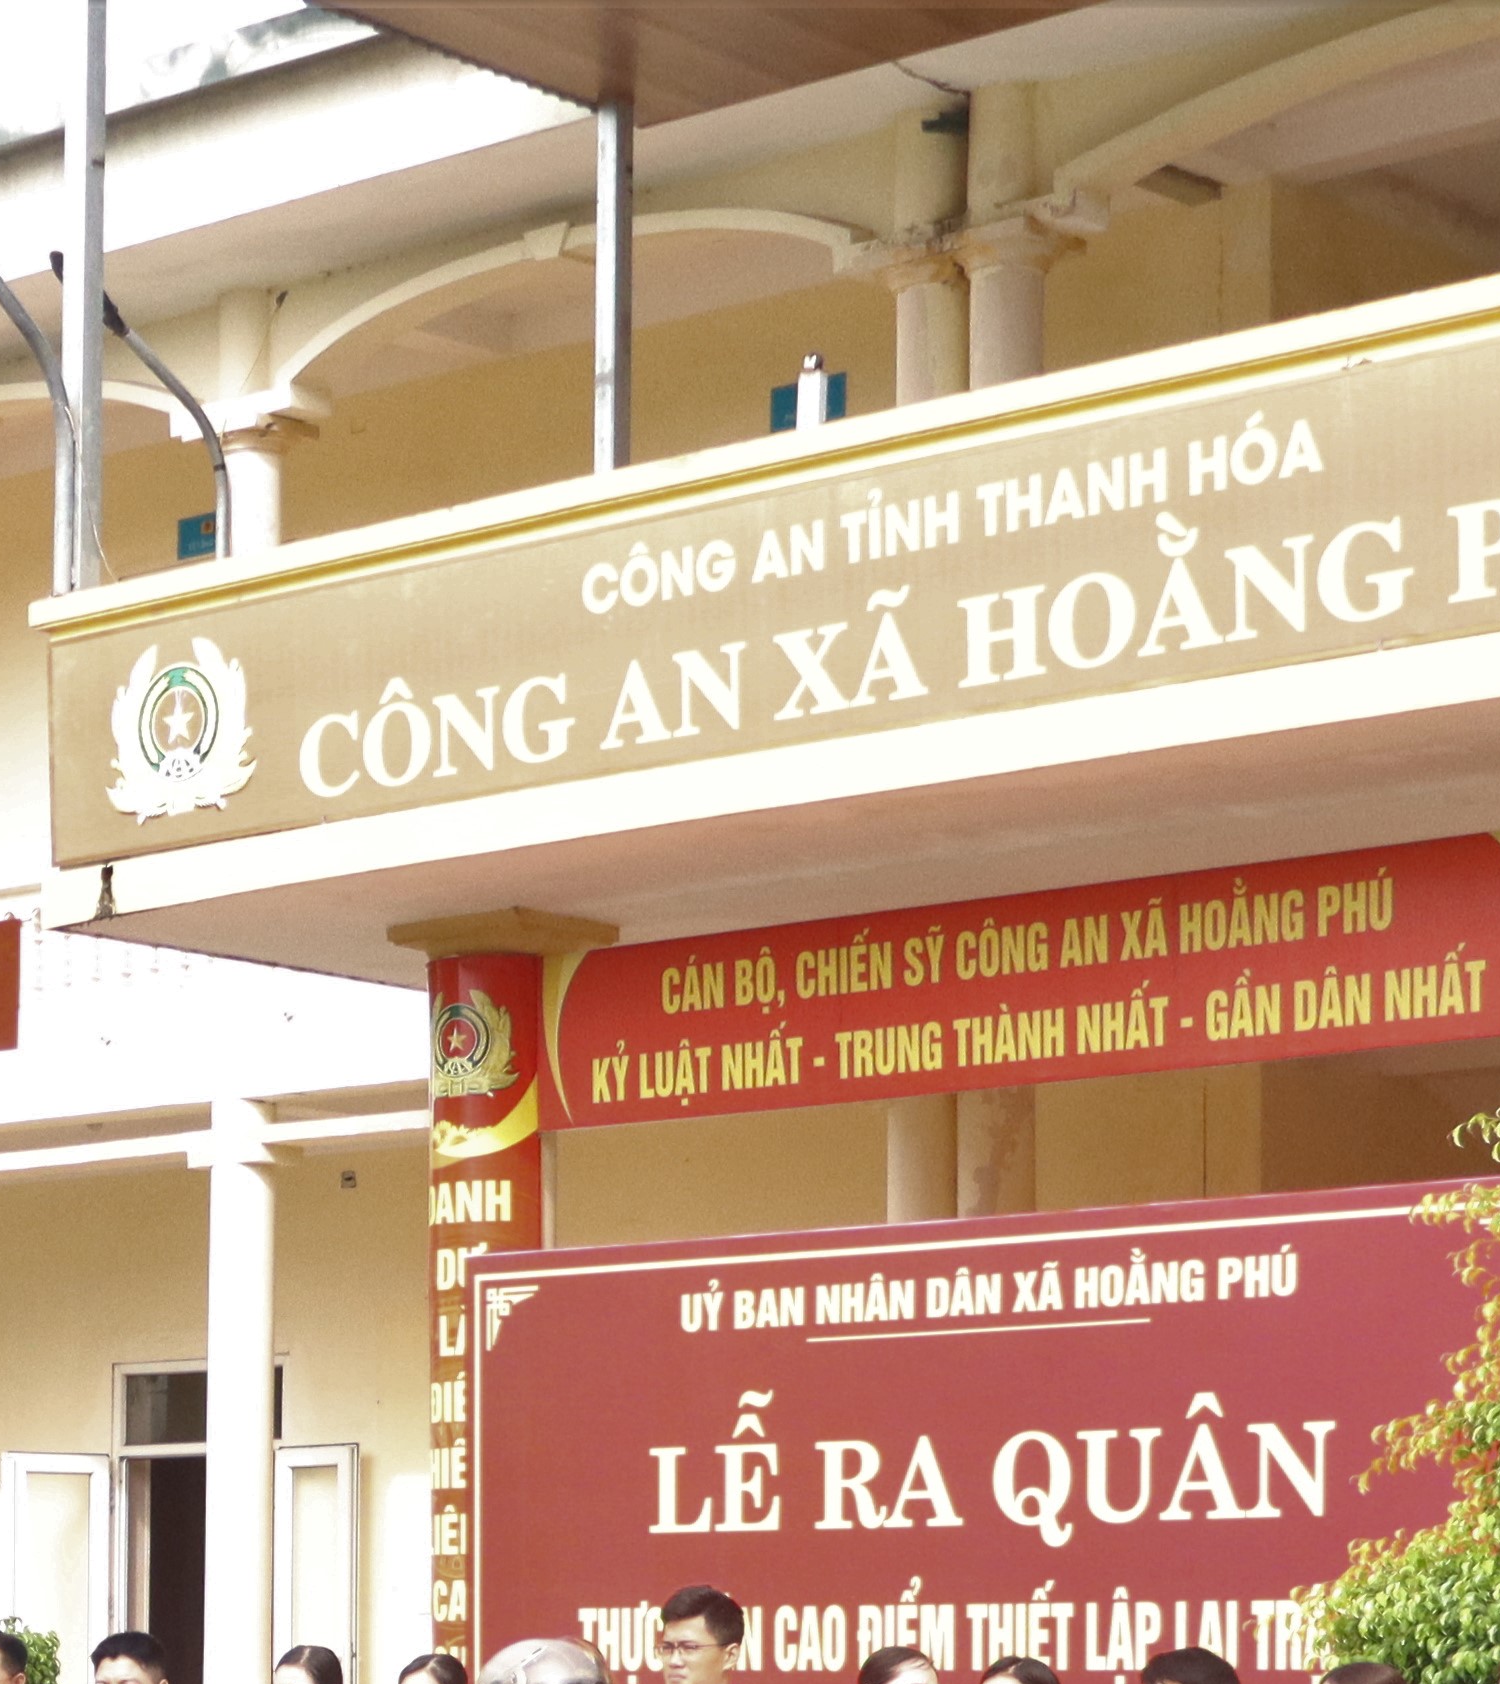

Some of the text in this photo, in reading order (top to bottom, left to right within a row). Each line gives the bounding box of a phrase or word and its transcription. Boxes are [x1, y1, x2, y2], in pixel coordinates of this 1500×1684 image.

[581, 410, 1324, 614] CÔNG AN TỈNH THANH HÓA
[298, 677, 576, 798] CÔNG
[600, 641, 748, 750] AN
[773, 585, 928, 722] XÃ
[956, 511, 1416, 690] HOẰNG
[661, 867, 1394, 1014] CÁN BỘ, CHIẾN SỸ CÔNG AN XÃ HOẰNG PHÚ
[592, 1040, 629, 1104] KỶ
[639, 1040, 711, 1106] LUẬT
[722, 1021, 803, 1091] NHẤT
[835, 1021, 942, 1080] TRUNG
[953, 1004, 1065, 1067] THÀNH
[1077, 980, 1169, 1055] NHẤT
[1206, 969, 1280, 1041] GẦN
[1294, 966, 1371, 1032] DÂN
[1384, 942, 1486, 1022] NHẤT
[679, 1244, 1297, 1332] UỶ BAN NHÂN DÂN XÃ HOẰNG PHÚ
[649, 1390, 1337, 1546] LỄ RA QUÂN
[433, 1579, 466, 1622] CA
[774, 1604, 847, 1672] CAO
[966, 1580, 1074, 1671] THIẾT
